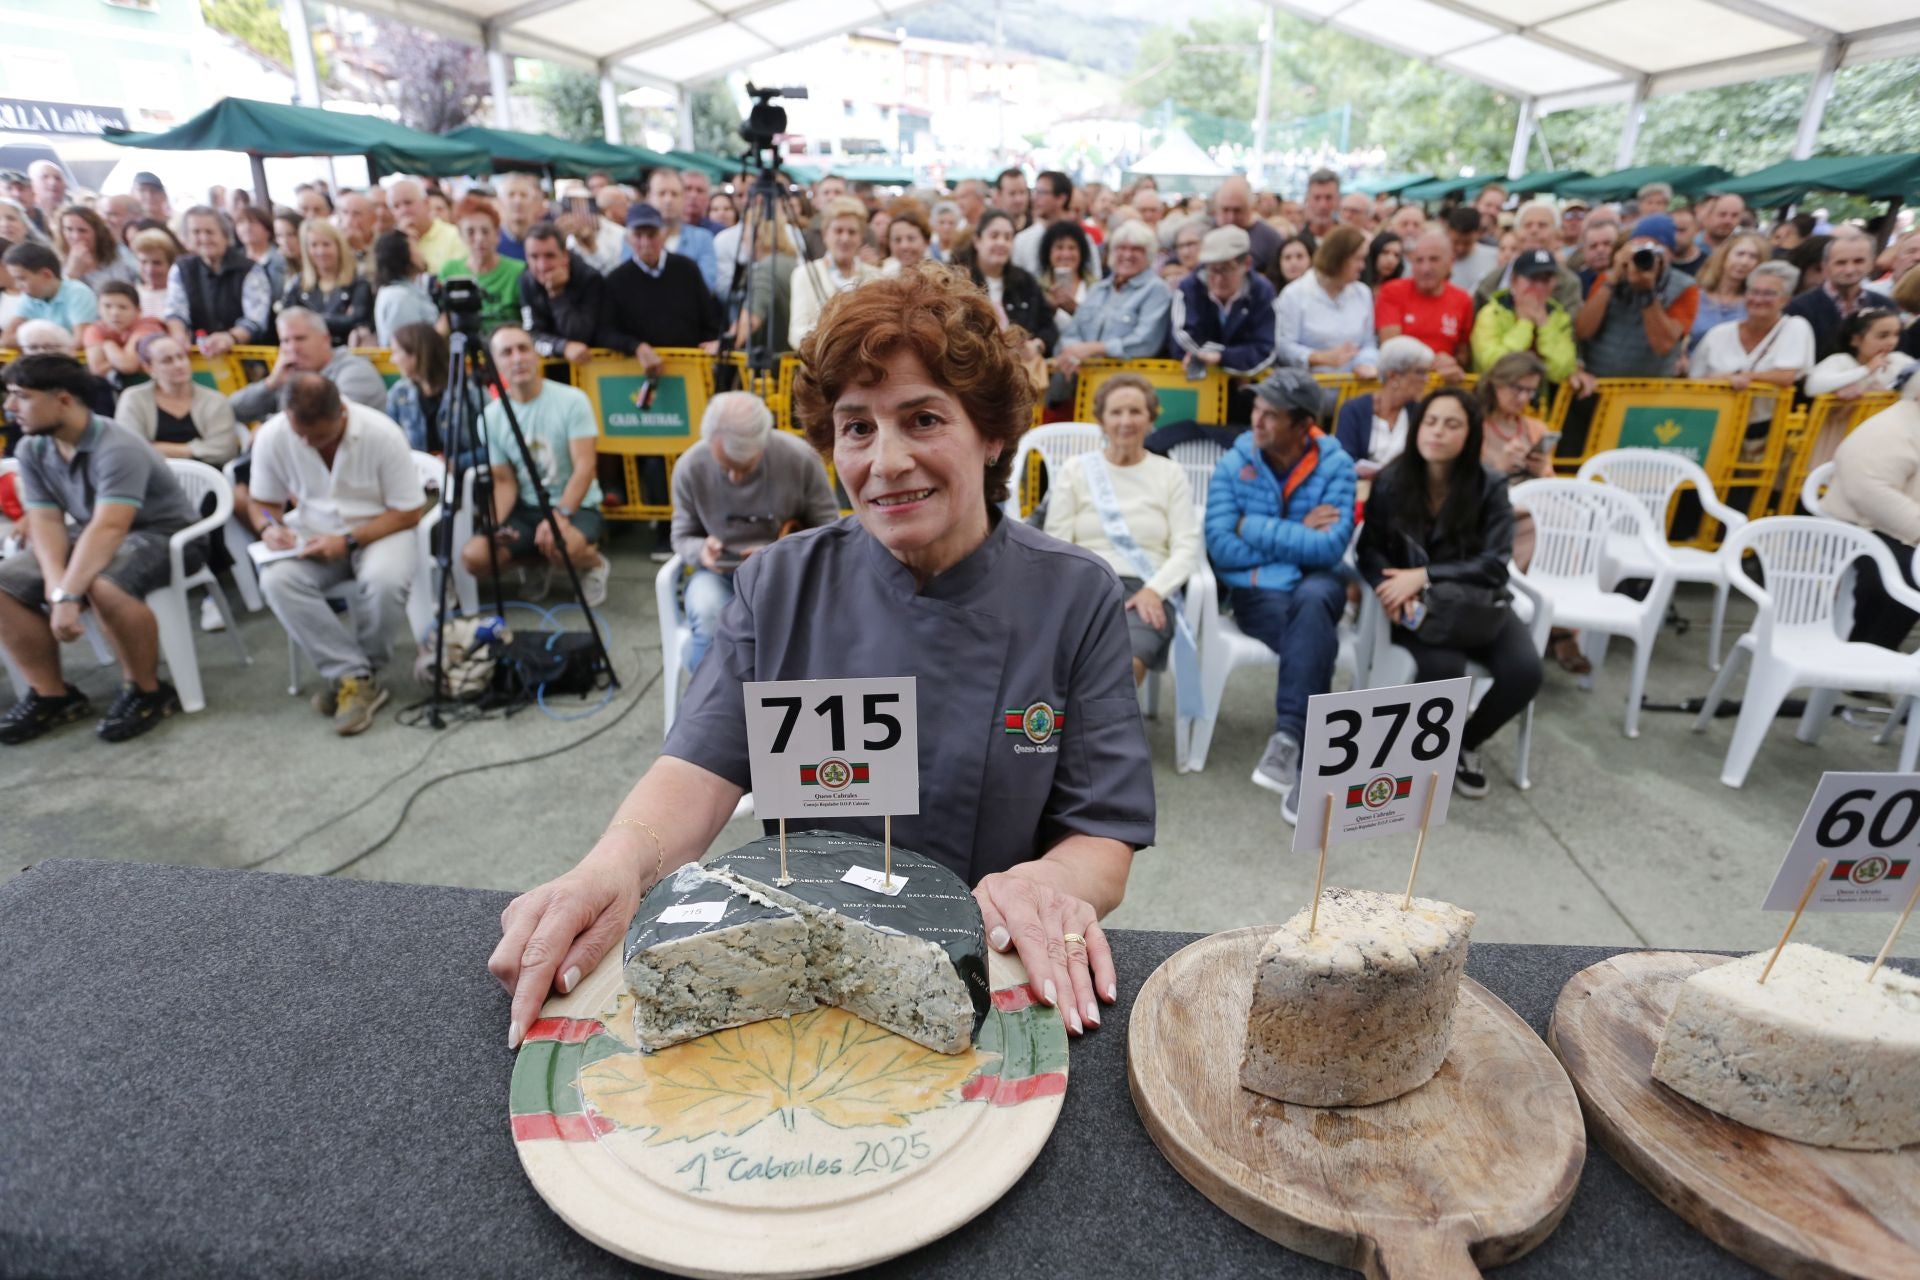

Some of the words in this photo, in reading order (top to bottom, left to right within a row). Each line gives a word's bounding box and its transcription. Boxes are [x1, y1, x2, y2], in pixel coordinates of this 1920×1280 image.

[761, 693, 902, 754] 715
[1014, 744, 1036, 754] Queso
[1318, 697, 1454, 777] 378
[1816, 788, 1920, 849] 60
[681, 907, 703, 918] 715
[728, 1153, 843, 1182] Cabrales
[853, 1131, 931, 1177] 2025
